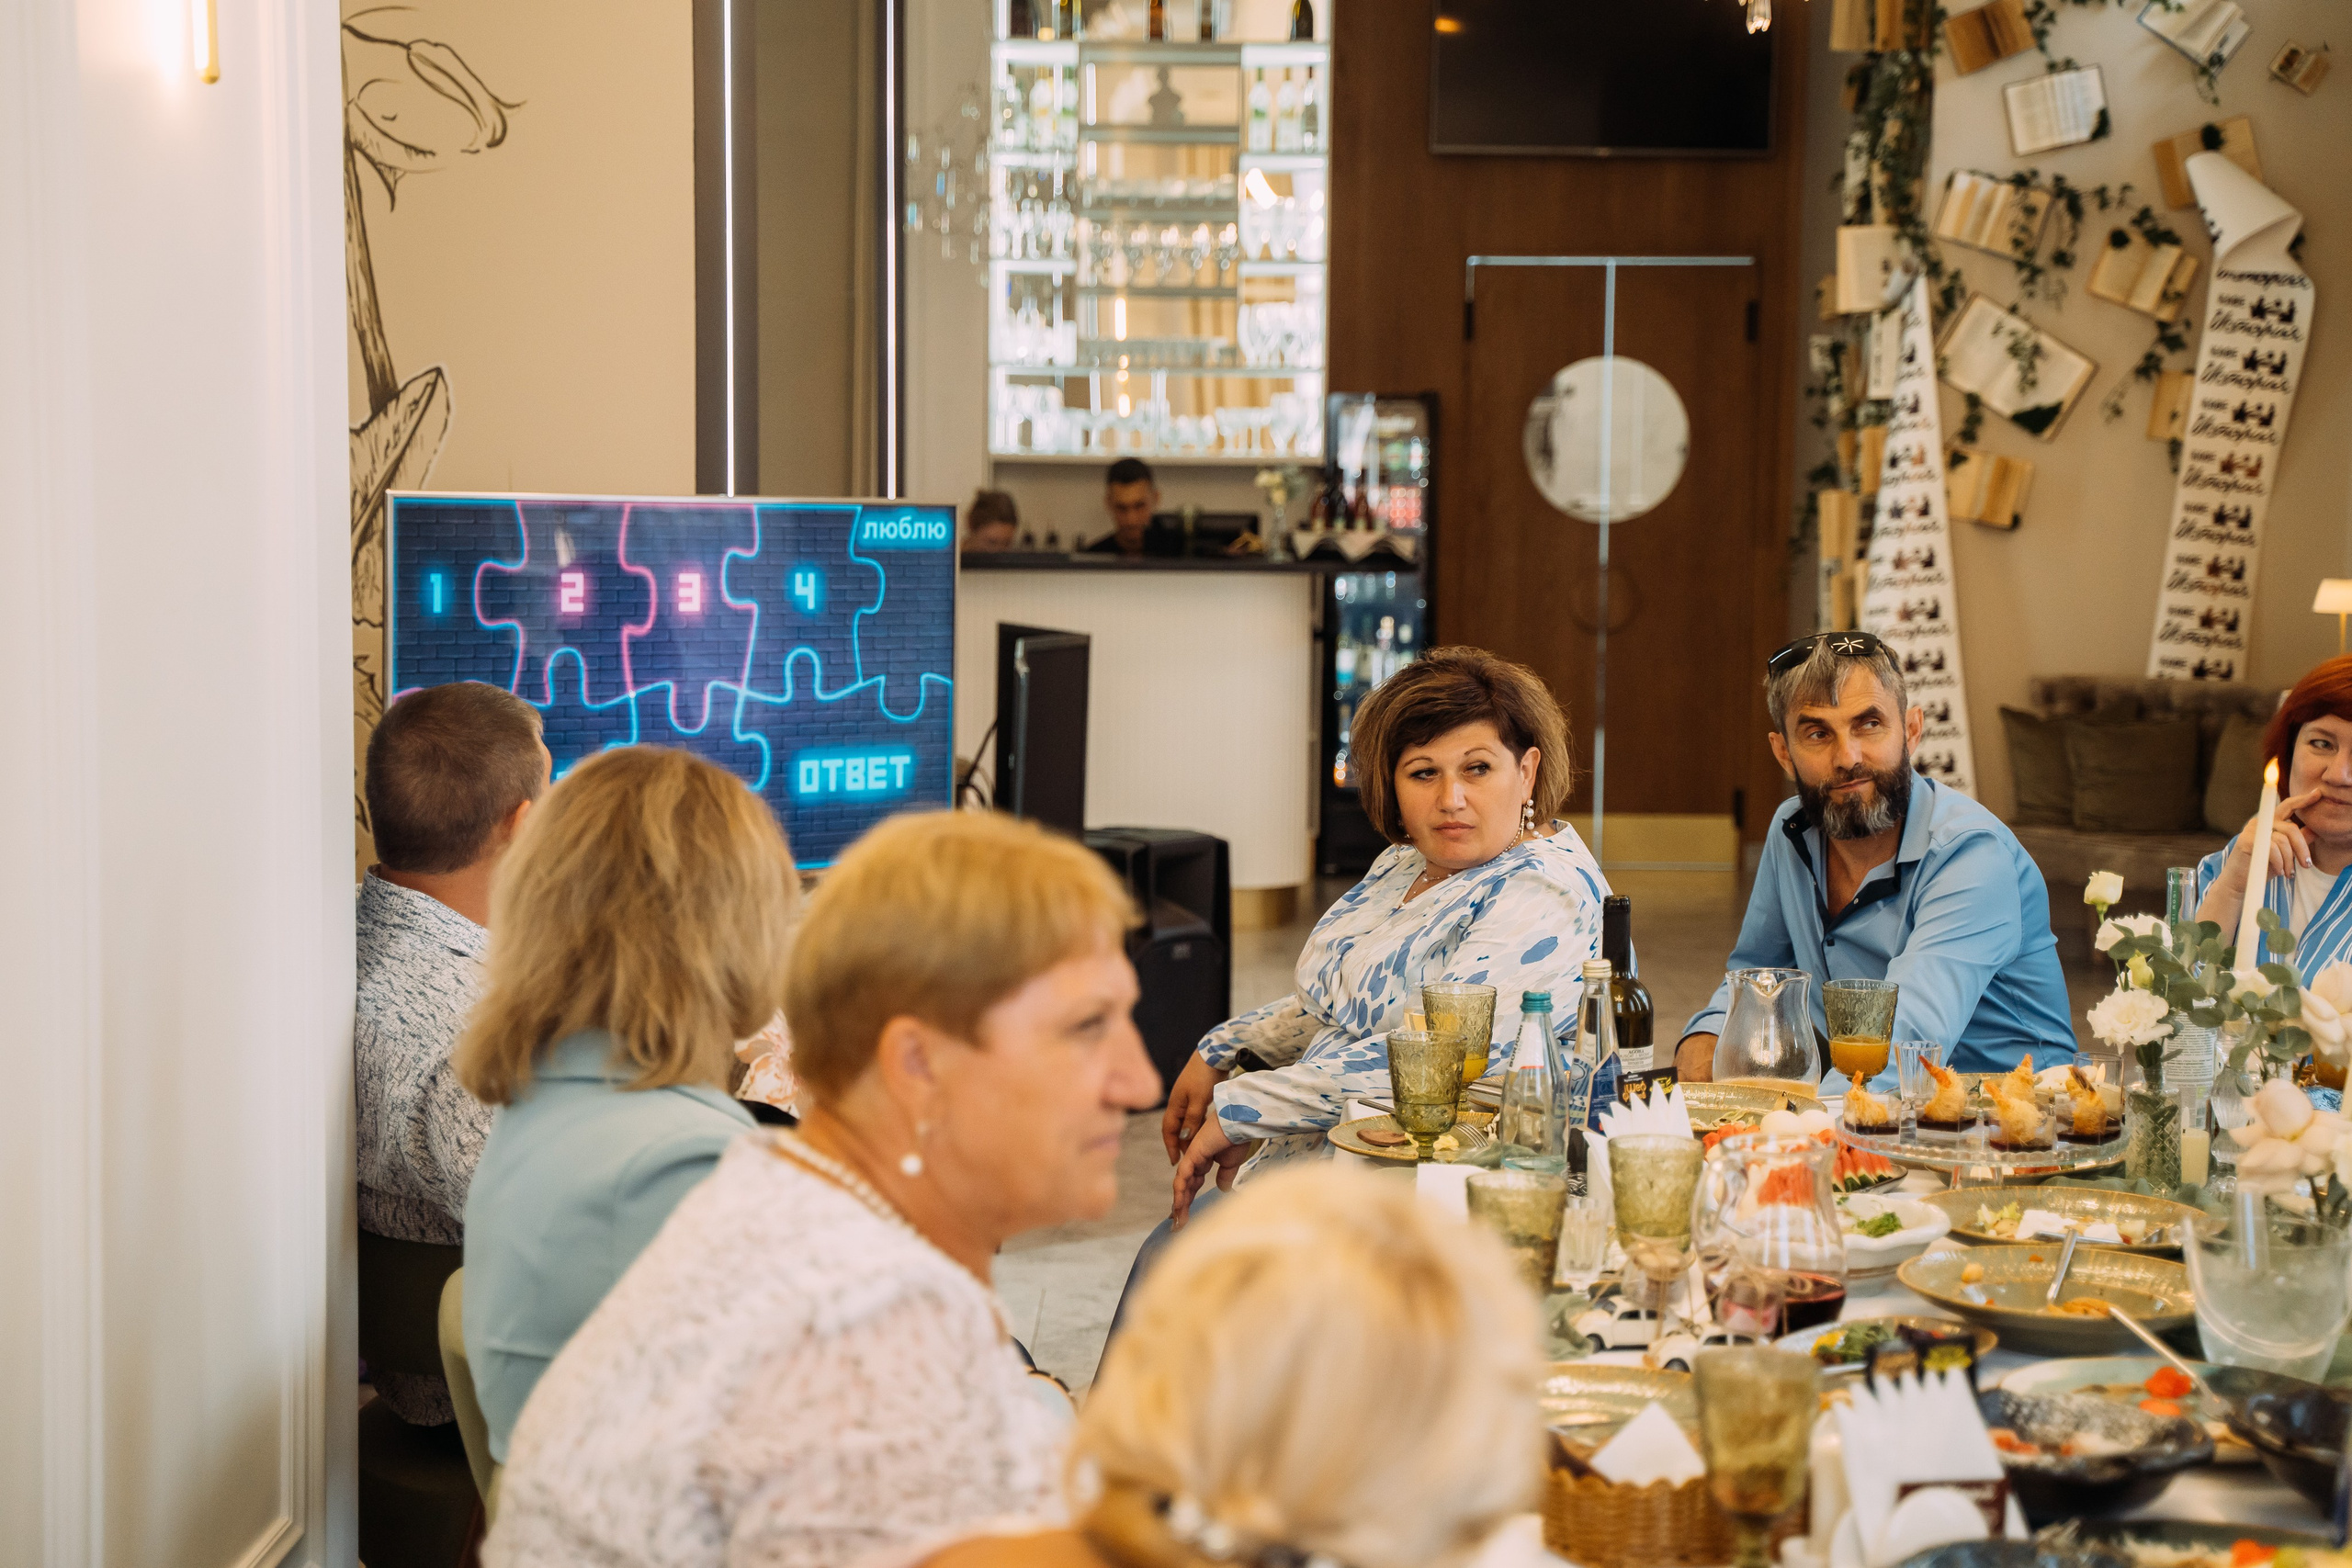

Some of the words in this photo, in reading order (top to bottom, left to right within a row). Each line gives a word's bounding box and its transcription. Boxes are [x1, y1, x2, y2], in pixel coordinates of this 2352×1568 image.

[863, 515, 946, 540] люблю
[430, 573, 442, 614] 1
[560, 572, 584, 613] 2
[678, 572, 700, 612] 3
[795, 572, 815, 610] 4
[799, 755, 910, 794] ОТВЕТ
[1509, 1024, 1523, 1067] BORJOMI
